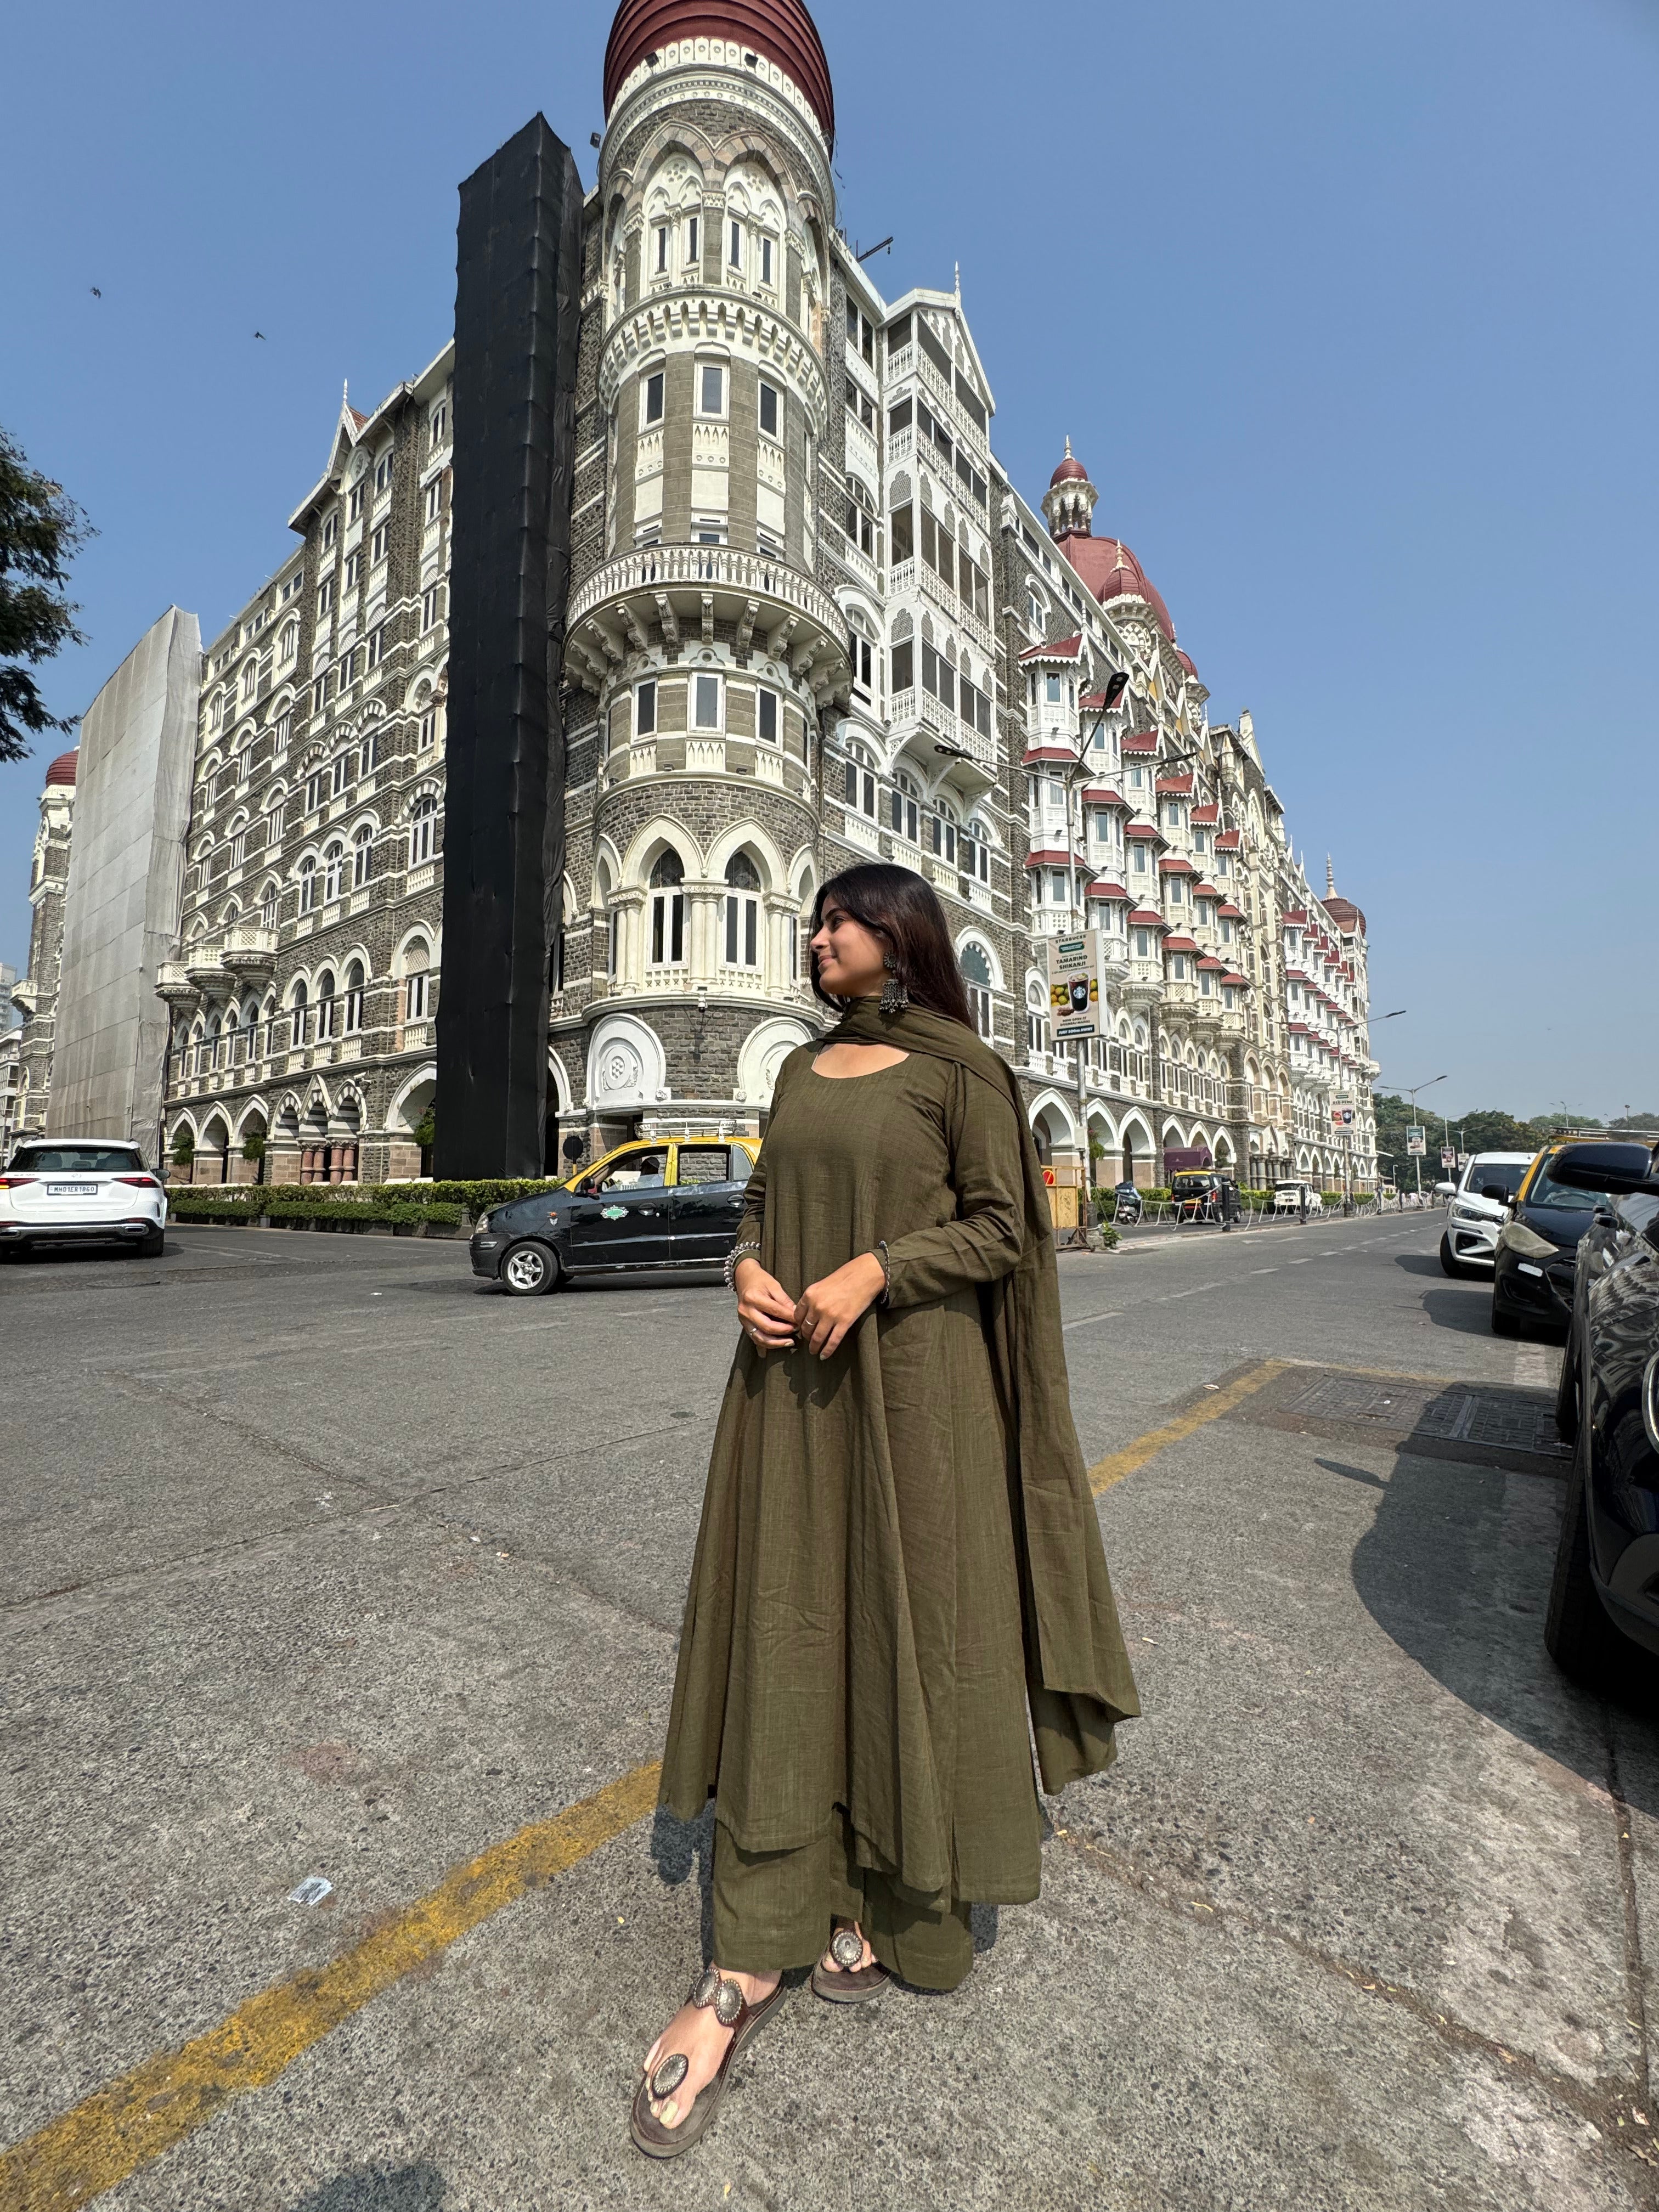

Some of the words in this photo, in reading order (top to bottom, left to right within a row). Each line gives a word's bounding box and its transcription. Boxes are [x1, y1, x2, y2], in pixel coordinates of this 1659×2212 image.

[1055, 934, 1086, 944] STARBUCKS
[1056, 955, 1087, 964] TAMARIND
[1059, 961, 1086, 969] SHIKANJI
